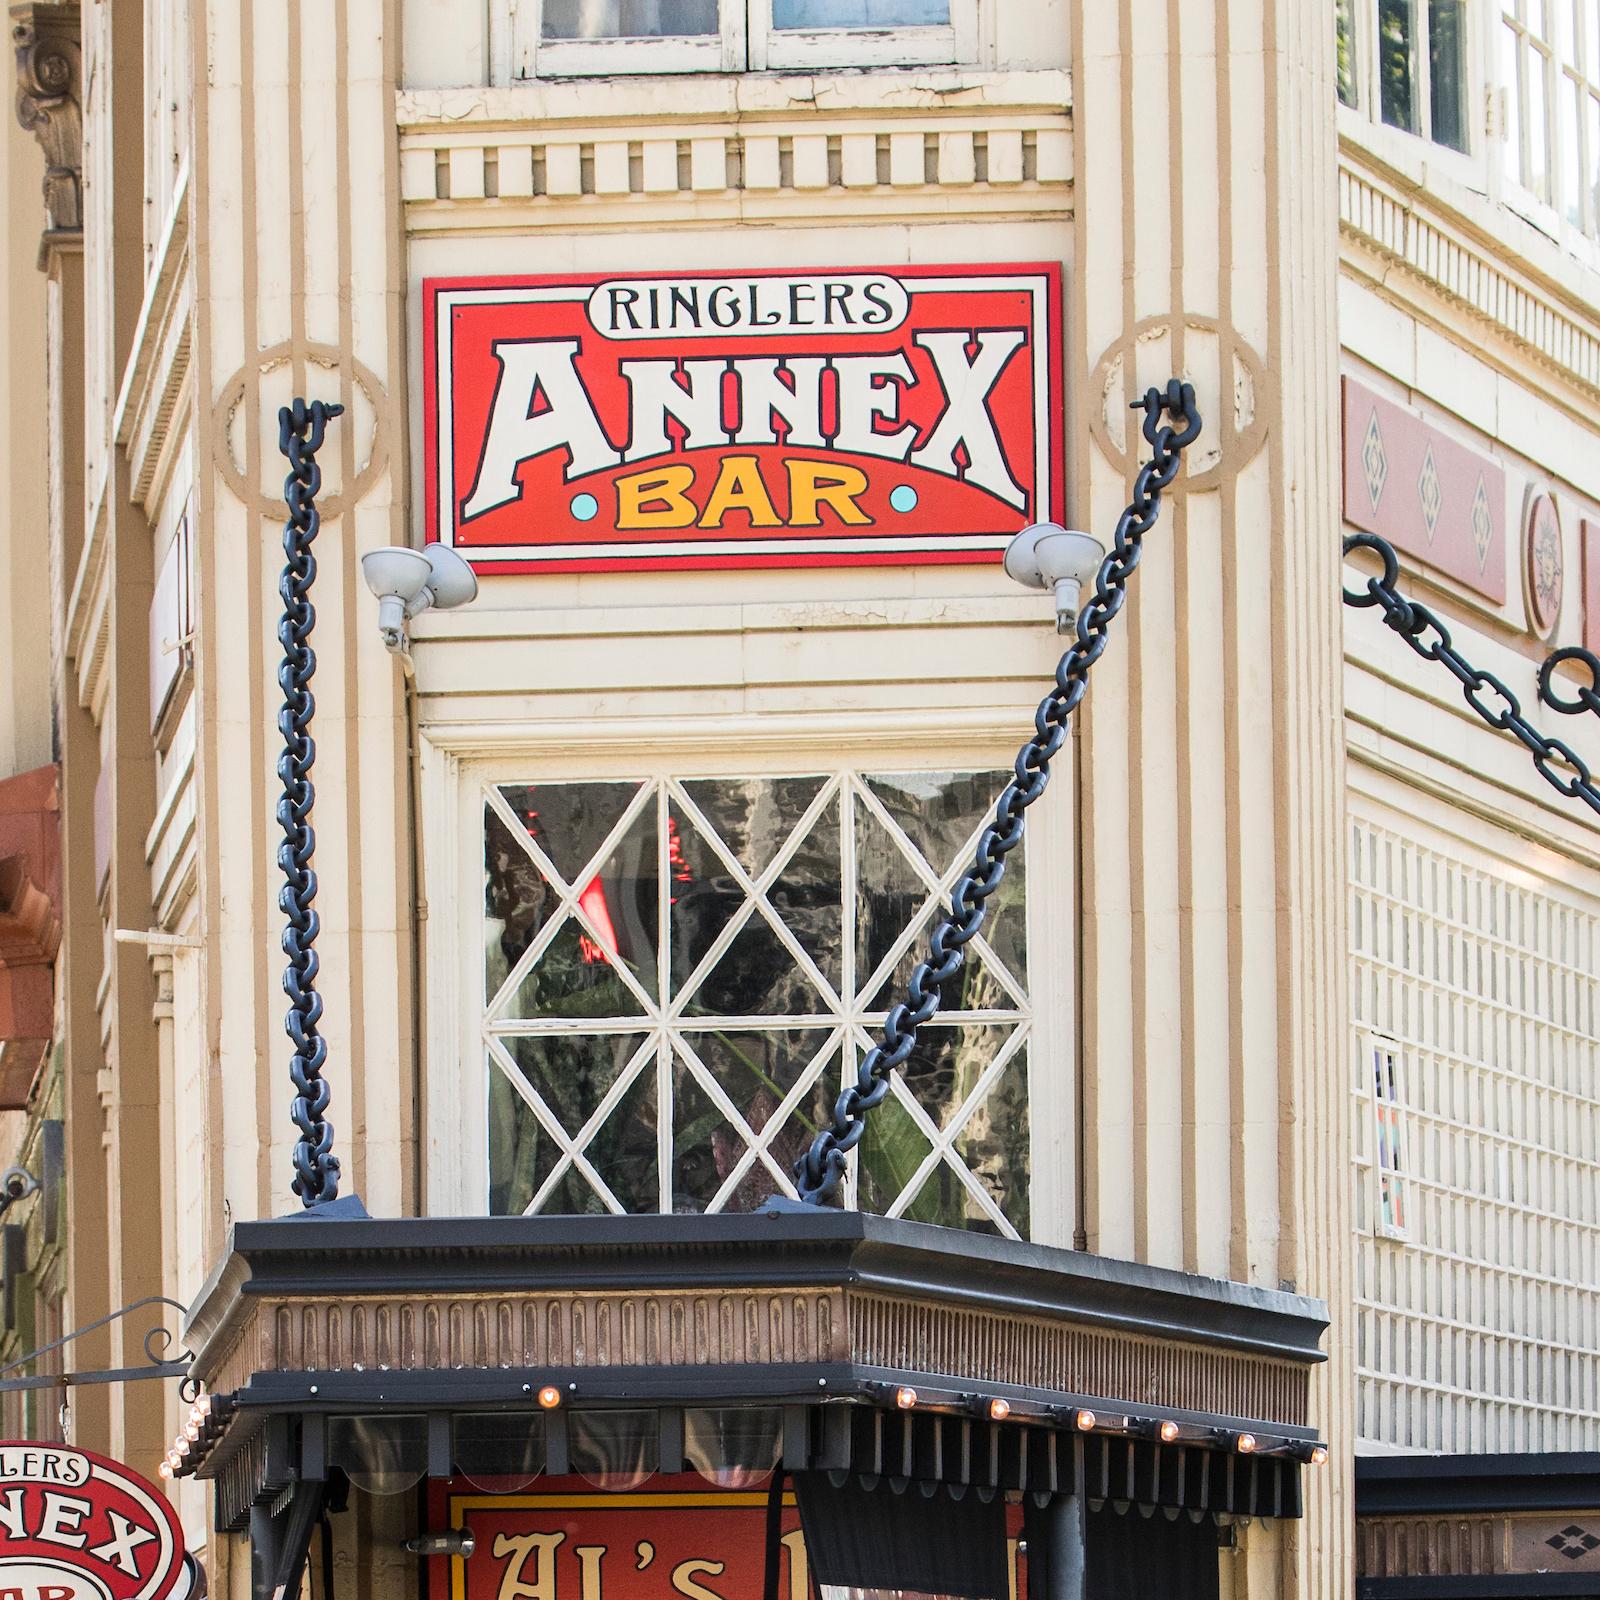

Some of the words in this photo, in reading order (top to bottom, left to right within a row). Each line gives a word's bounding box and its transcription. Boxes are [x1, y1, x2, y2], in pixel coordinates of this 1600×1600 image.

[606, 282, 894, 331] RINGLERS
[461, 327, 1029, 525] ANNEX
[613, 454, 875, 531] BAR
